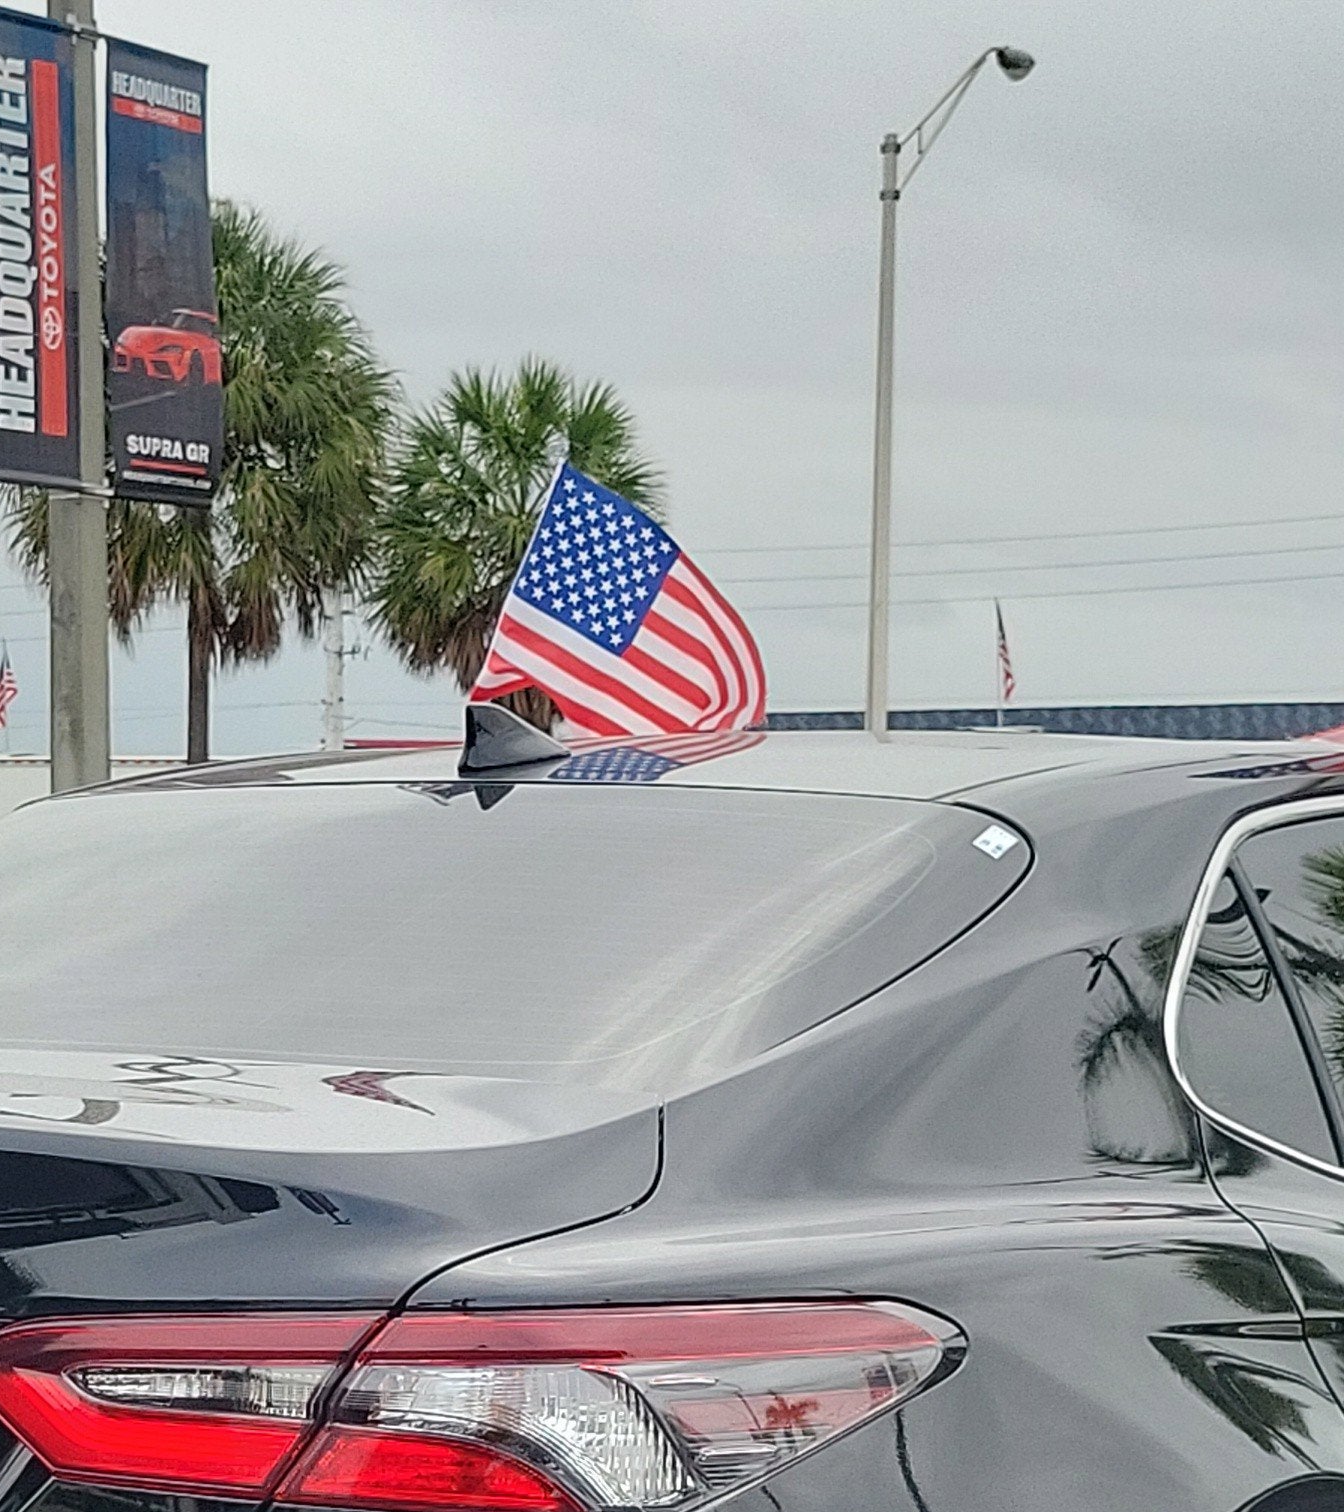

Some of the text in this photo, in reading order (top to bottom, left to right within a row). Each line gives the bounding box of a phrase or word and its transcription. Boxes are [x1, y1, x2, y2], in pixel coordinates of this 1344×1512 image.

[112, 70, 202, 117] HEADQUARTER
[38, 163, 61, 304] TOYOTA
[126, 434, 210, 465] SUPRA GR
